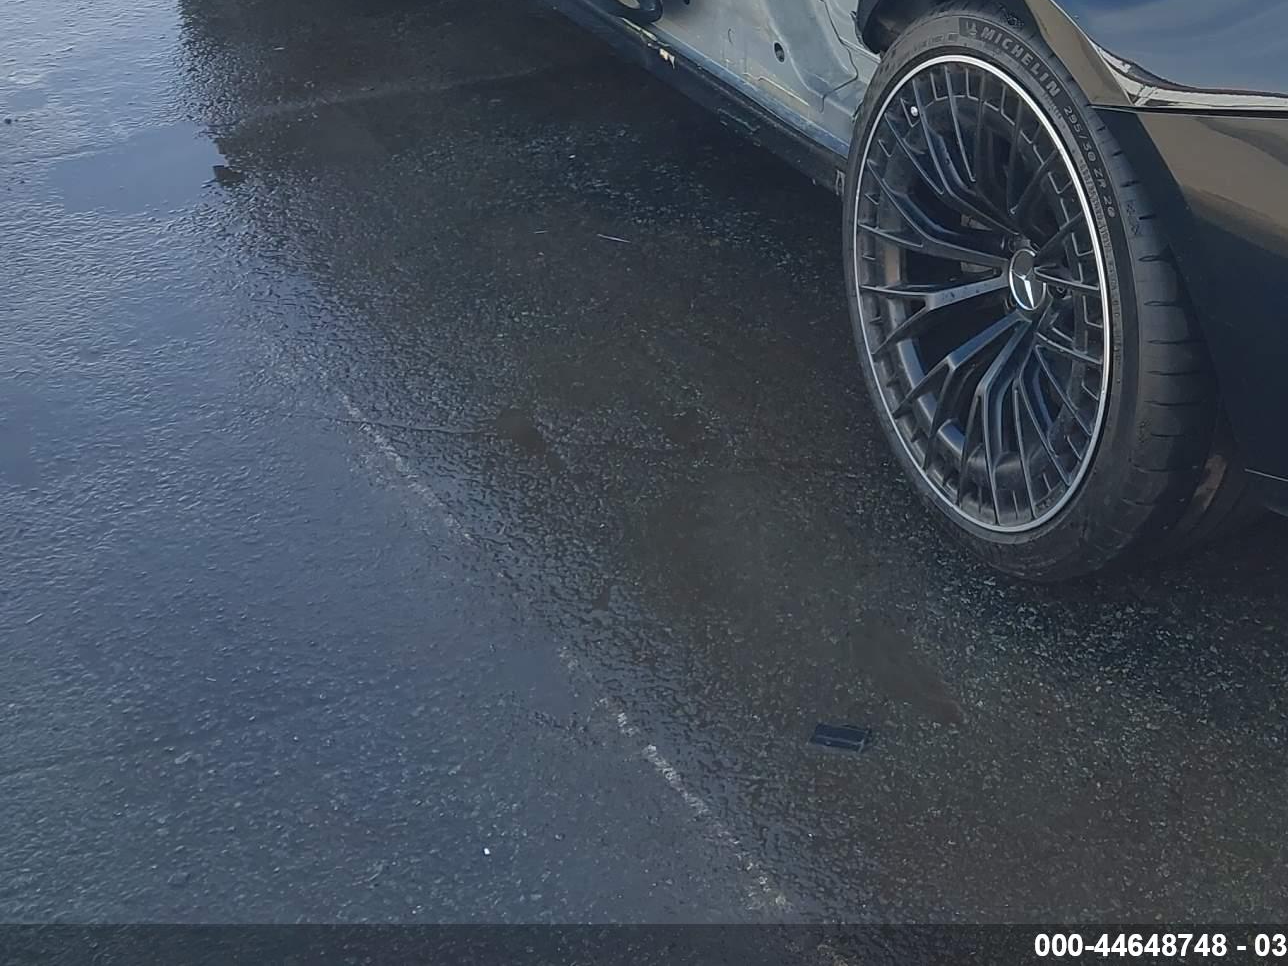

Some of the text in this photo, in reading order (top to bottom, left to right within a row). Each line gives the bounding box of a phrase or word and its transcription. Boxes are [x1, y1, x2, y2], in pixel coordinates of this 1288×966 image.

[980, 25, 1061, 97] MICHELIN
[1063, 105, 1097, 162] 295/30
[1093, 168, 1107, 189] ZR
[1103, 195, 1116, 218] 20
